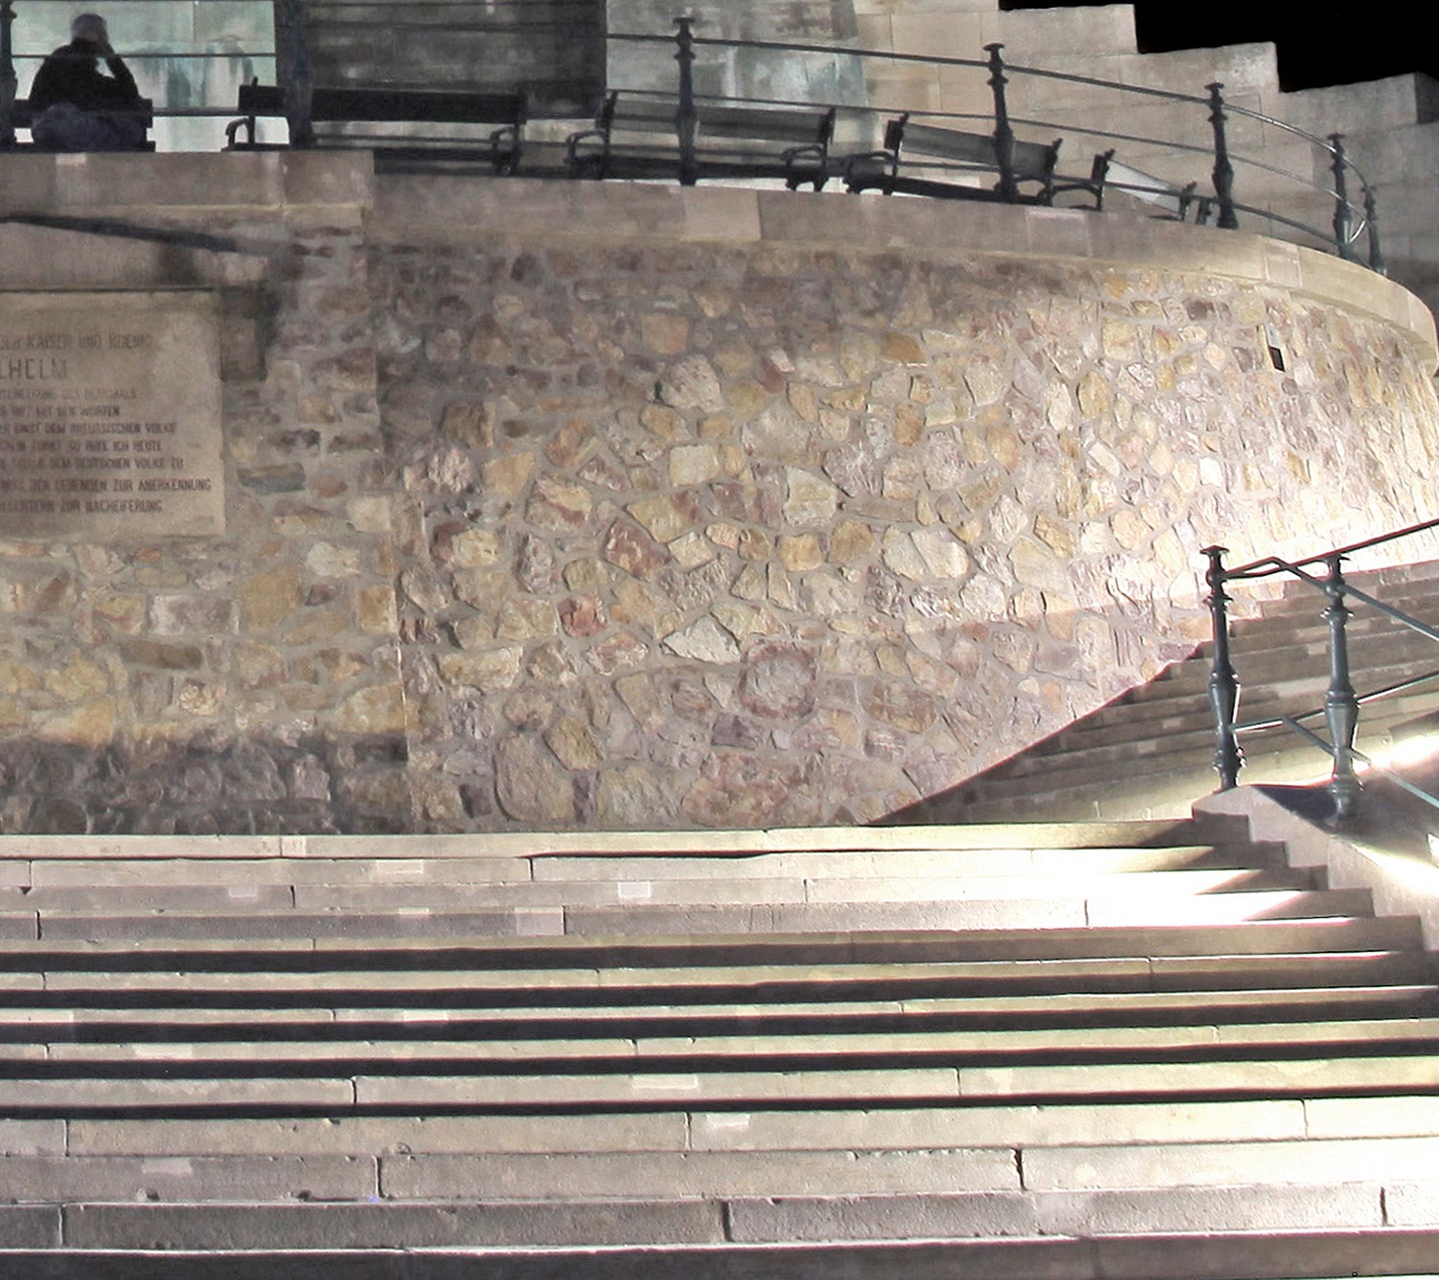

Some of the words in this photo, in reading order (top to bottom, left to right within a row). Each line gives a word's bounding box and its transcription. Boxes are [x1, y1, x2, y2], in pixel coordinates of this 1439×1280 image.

[112, 479, 133, 493] ZUR
[137, 479, 212, 493] ANERKENNUNG
[84, 499, 163, 513] NACHEIFERUNG
